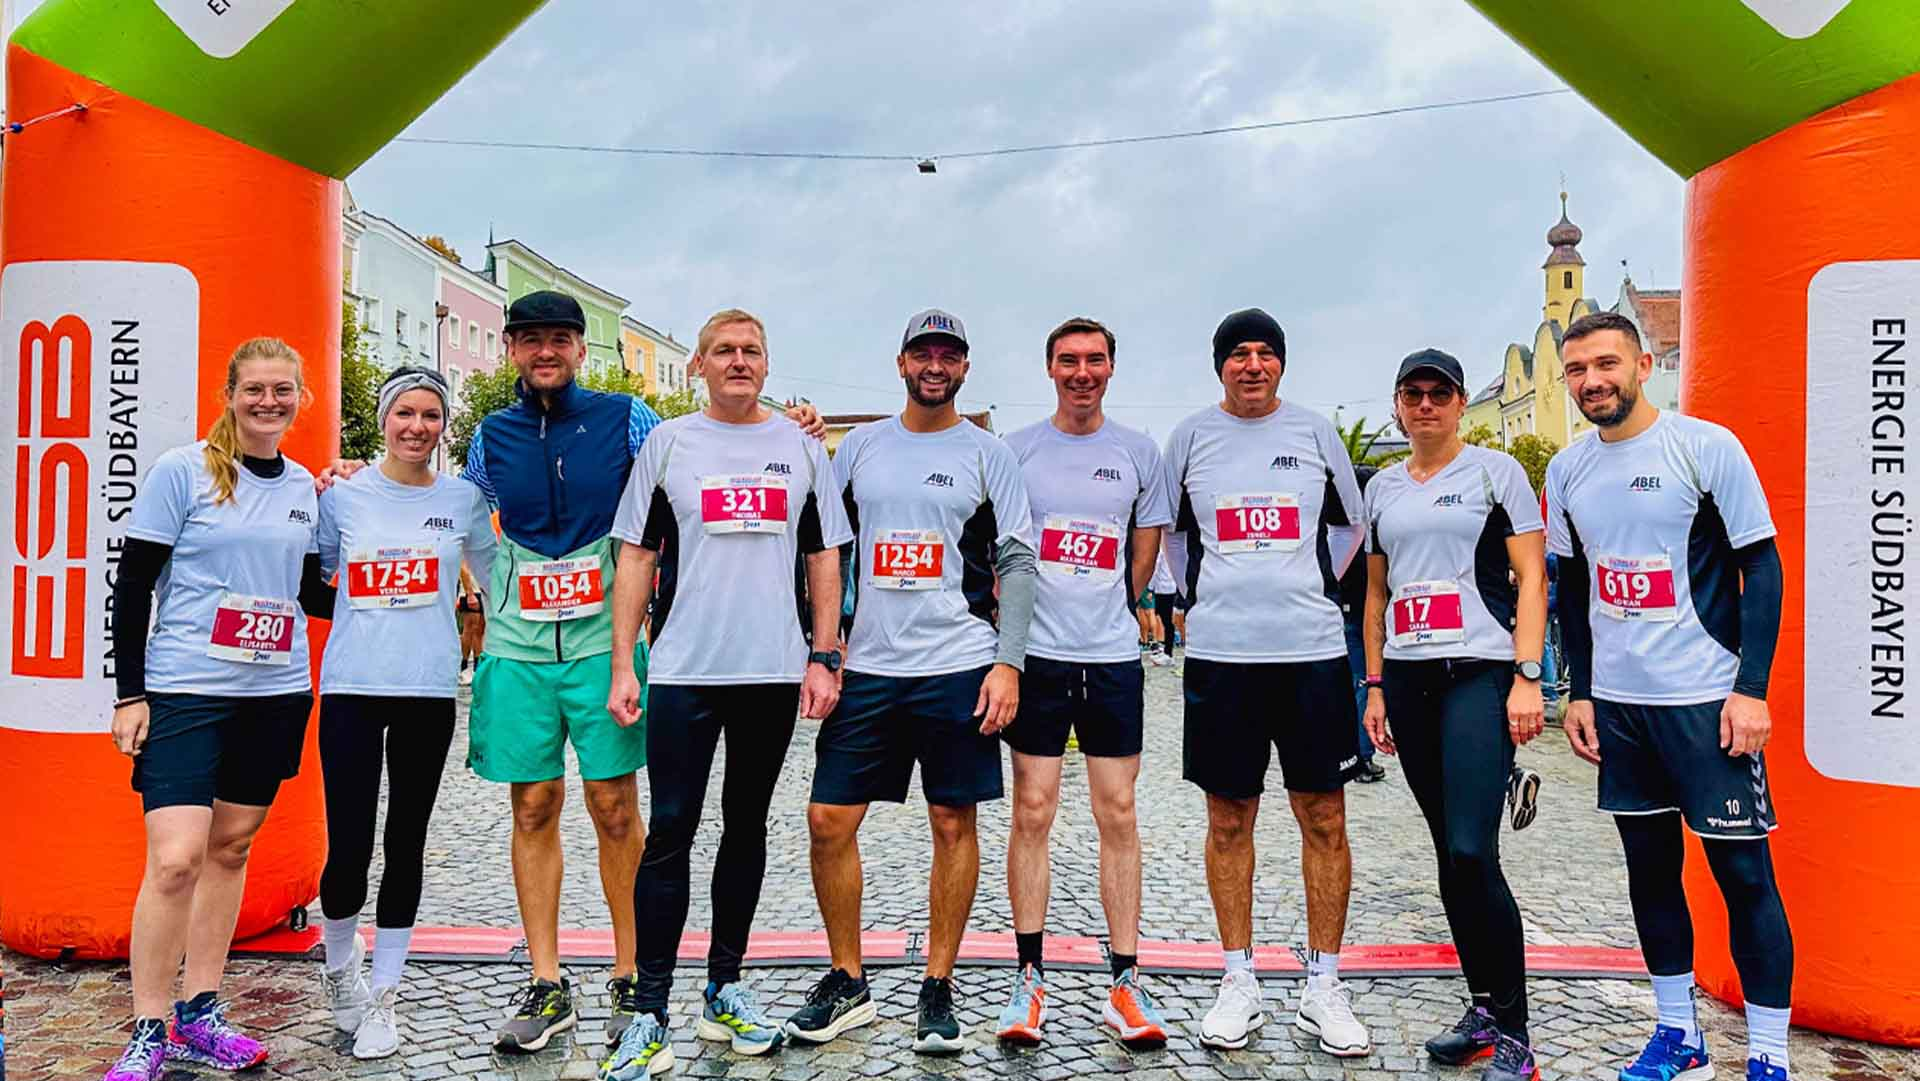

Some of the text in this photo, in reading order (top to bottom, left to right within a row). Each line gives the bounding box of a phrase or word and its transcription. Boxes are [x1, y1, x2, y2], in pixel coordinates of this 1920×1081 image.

[100, 319, 140, 522] SÜDBAYERN
[764, 463, 792, 474] ABEL
[1270, 456, 1299, 467] ABEL
[926, 473, 954, 487] ABEL
[1093, 468, 1121, 480] ABEL
[1629, 476, 1662, 489] ABEL
[12, 313, 92, 680] ESB
[722, 489, 767, 512] 321
[1433, 494, 1463, 505] ABEL
[423, 517, 455, 529] ABEL
[1235, 508, 1281, 532] 108
[1871, 319, 1913, 719] ENERGIE SÜDBAYERN
[879, 545, 934, 569] 1254
[1058, 533, 1104, 559] 467
[361, 560, 428, 589] 1754
[530, 572, 591, 601] 1054
[1604, 570, 1650, 600] 619
[1404, 597, 1432, 624] 17
[235, 613, 285, 642] 280
[1725, 799, 1740, 815] 10
[1718, 816, 1752, 828] hummel
